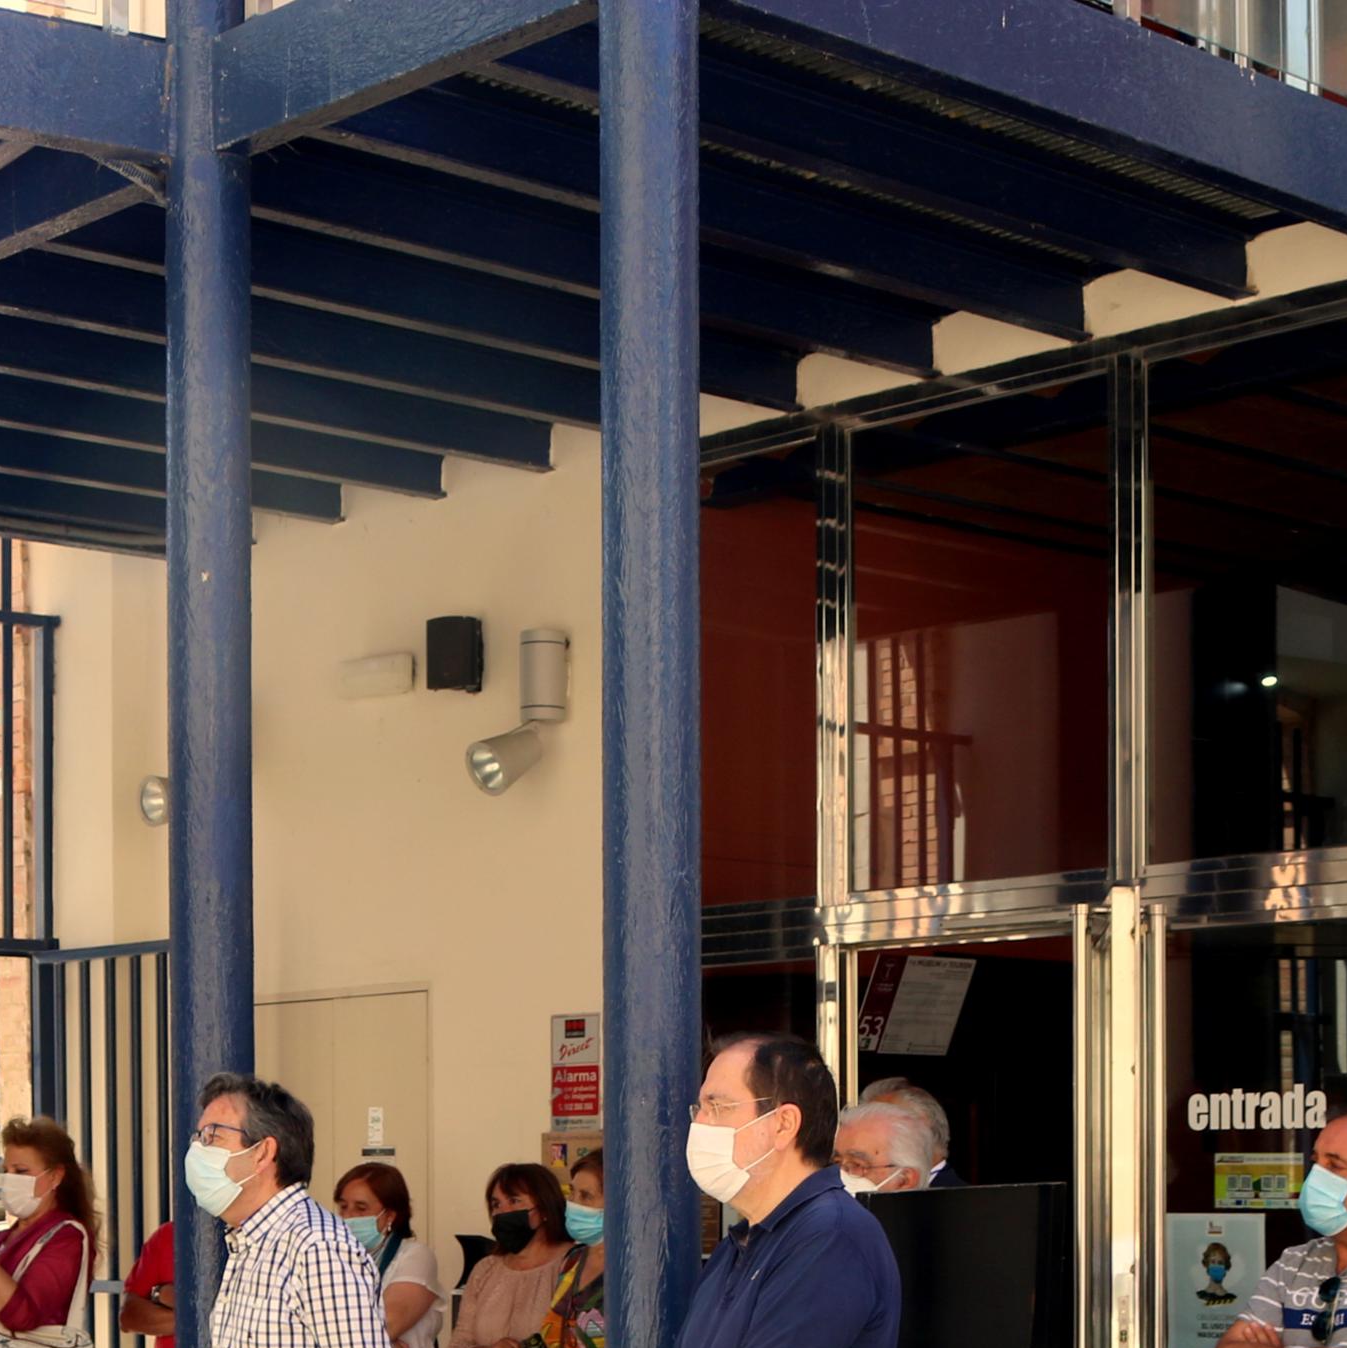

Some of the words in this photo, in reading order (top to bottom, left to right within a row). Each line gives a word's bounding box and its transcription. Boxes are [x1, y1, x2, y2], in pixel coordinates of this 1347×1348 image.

[859, 1015, 884, 1037] 53
[554, 1069, 597, 1083] Alarma
[1187, 1083, 1327, 1131] entrada
